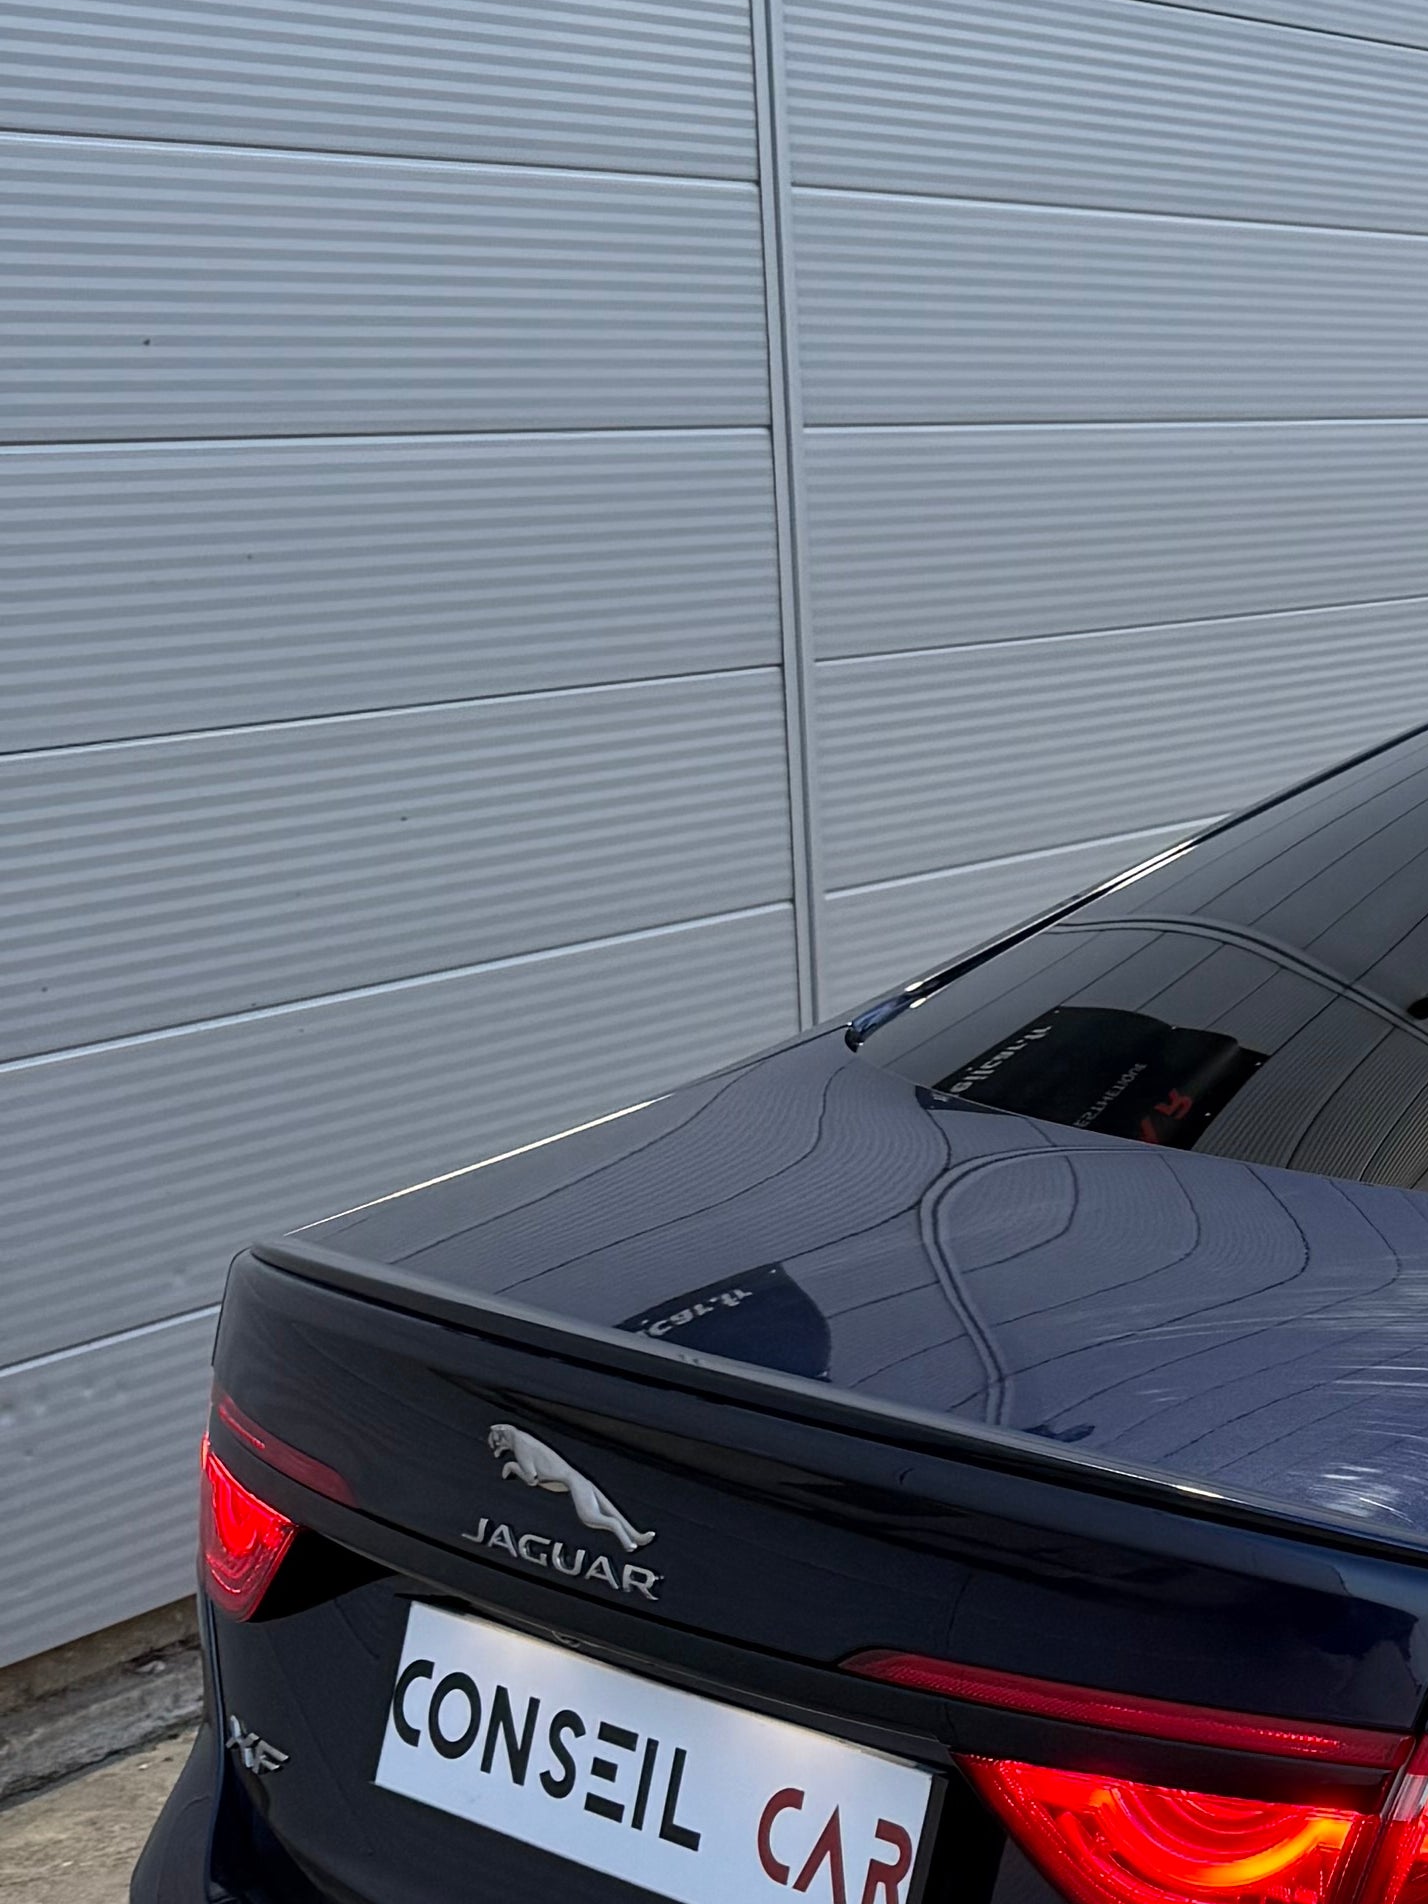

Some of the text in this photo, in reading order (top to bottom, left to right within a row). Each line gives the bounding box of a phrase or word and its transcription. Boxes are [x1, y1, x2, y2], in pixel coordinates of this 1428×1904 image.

[460, 1517, 663, 1601] JAGUAR
[225, 1714, 290, 1775] XF
[391, 1658, 702, 1853] CONSEIL
